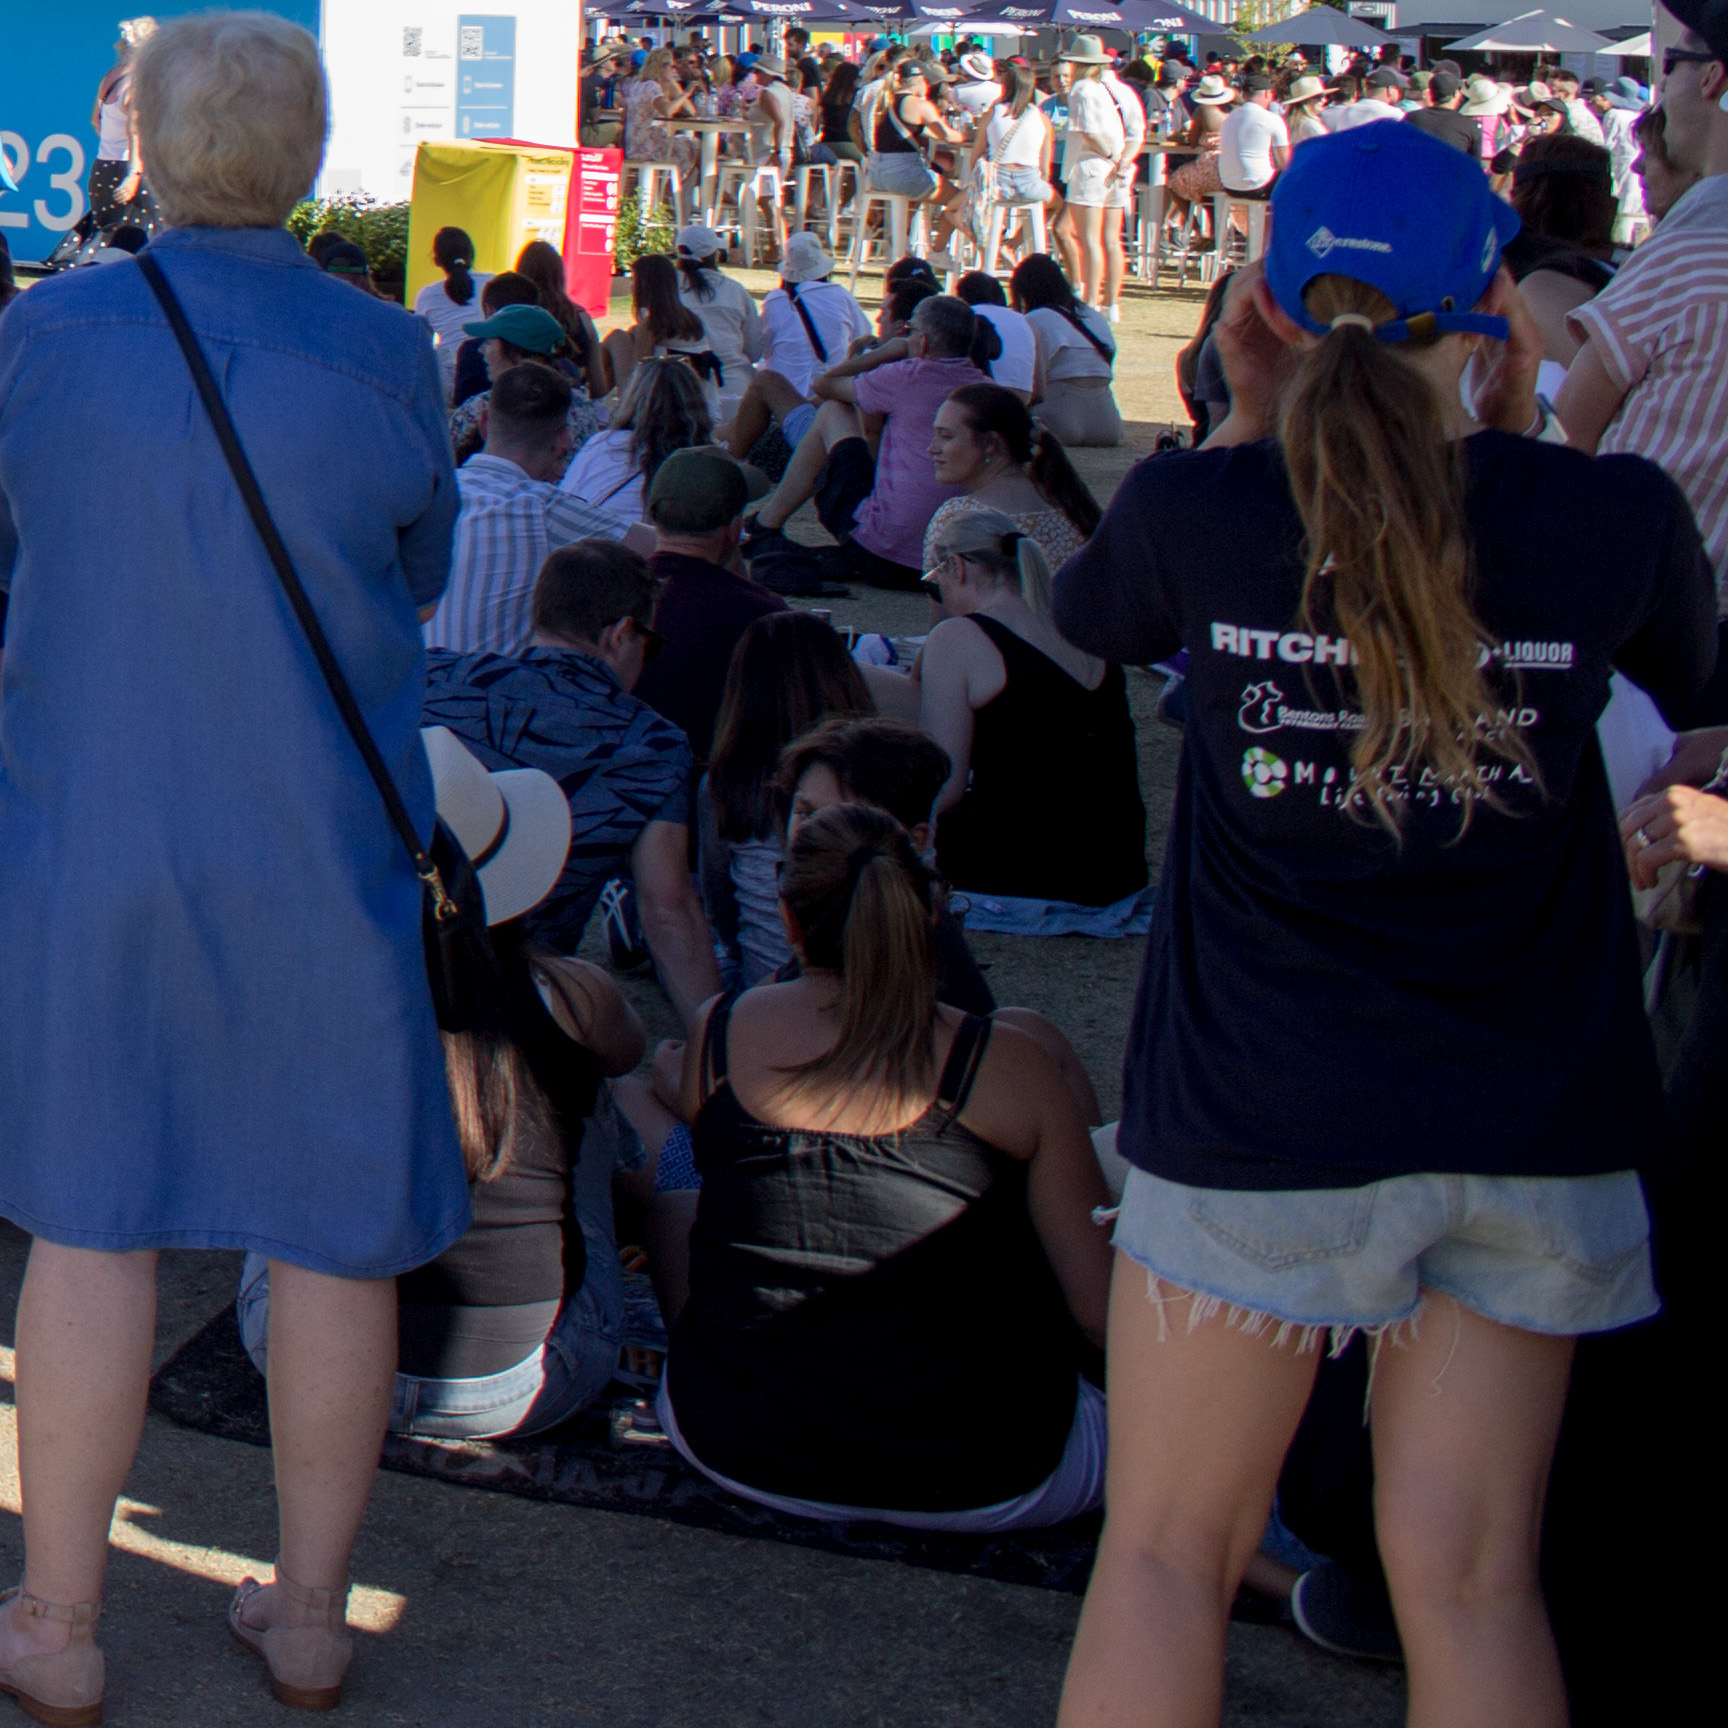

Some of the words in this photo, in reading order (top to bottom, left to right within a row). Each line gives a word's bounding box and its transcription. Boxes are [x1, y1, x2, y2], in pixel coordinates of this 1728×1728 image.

[751, 0, 813, 13] PERONI
[1066, 9, 1123, 22] PERONI
[1504, 642, 1575, 664] LIQUOR
[1278, 705, 1337, 724] Bentons
